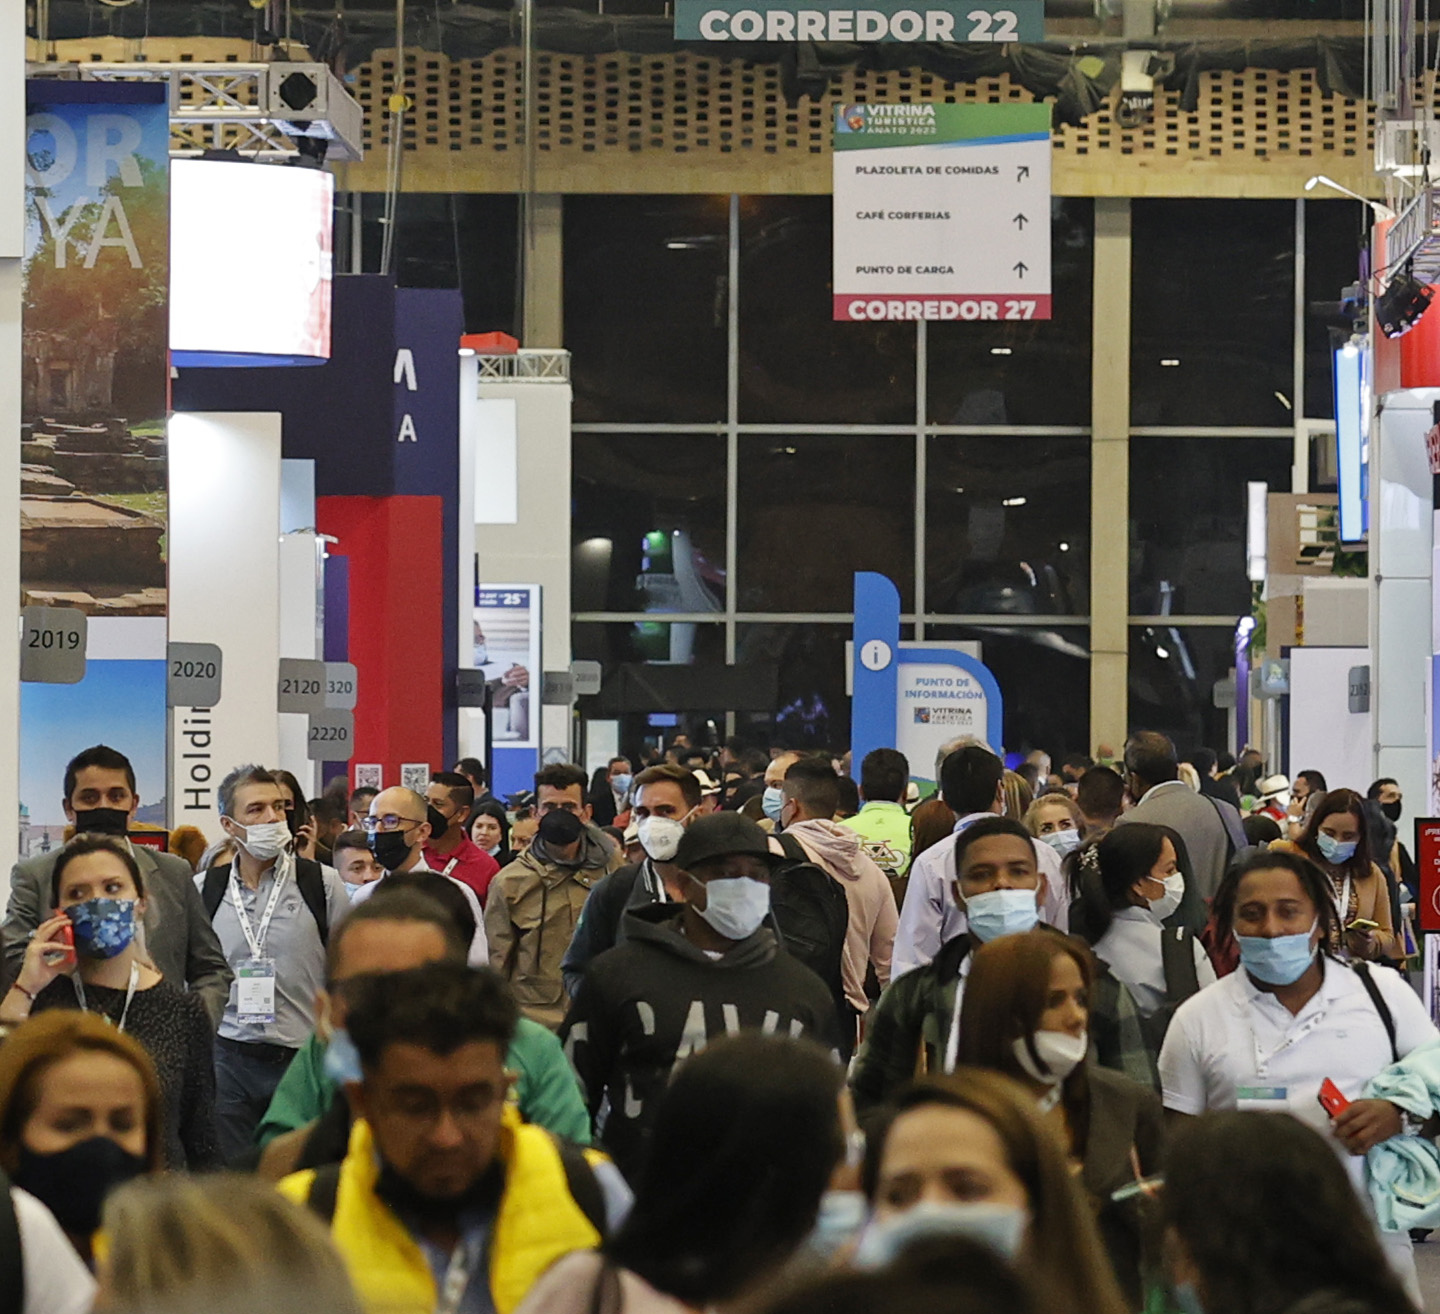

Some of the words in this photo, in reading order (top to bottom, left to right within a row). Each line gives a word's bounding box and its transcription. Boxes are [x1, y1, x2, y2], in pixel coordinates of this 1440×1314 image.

[699, 10, 955, 41] CORREDOR
[967, 10, 1019, 41] 22
[867, 104, 936, 116] VITRINA
[856, 166, 922, 175] PLAZOLETA
[926, 166, 942, 175] DE
[945, 166, 999, 175] COMIDAS
[856, 210, 885, 220] CAFÉ
[888, 211, 951, 220] CORFERIAS
[856, 265, 894, 274] PUNTO
[897, 265, 911, 274] DE
[915, 265, 954, 274] CARGA
[848, 299, 998, 321] CORREDOR
[1004, 300, 1037, 321] 27
[28, 629, 80, 649] 2019
[173, 660, 216, 678] 2020
[282, 680, 320, 694] 2120
[328, 681, 353, 694] 320
[916, 678, 953, 686] PUNTO
[905, 690, 982, 699] INFORMACIÓN
[310, 727, 347, 741] 2220
